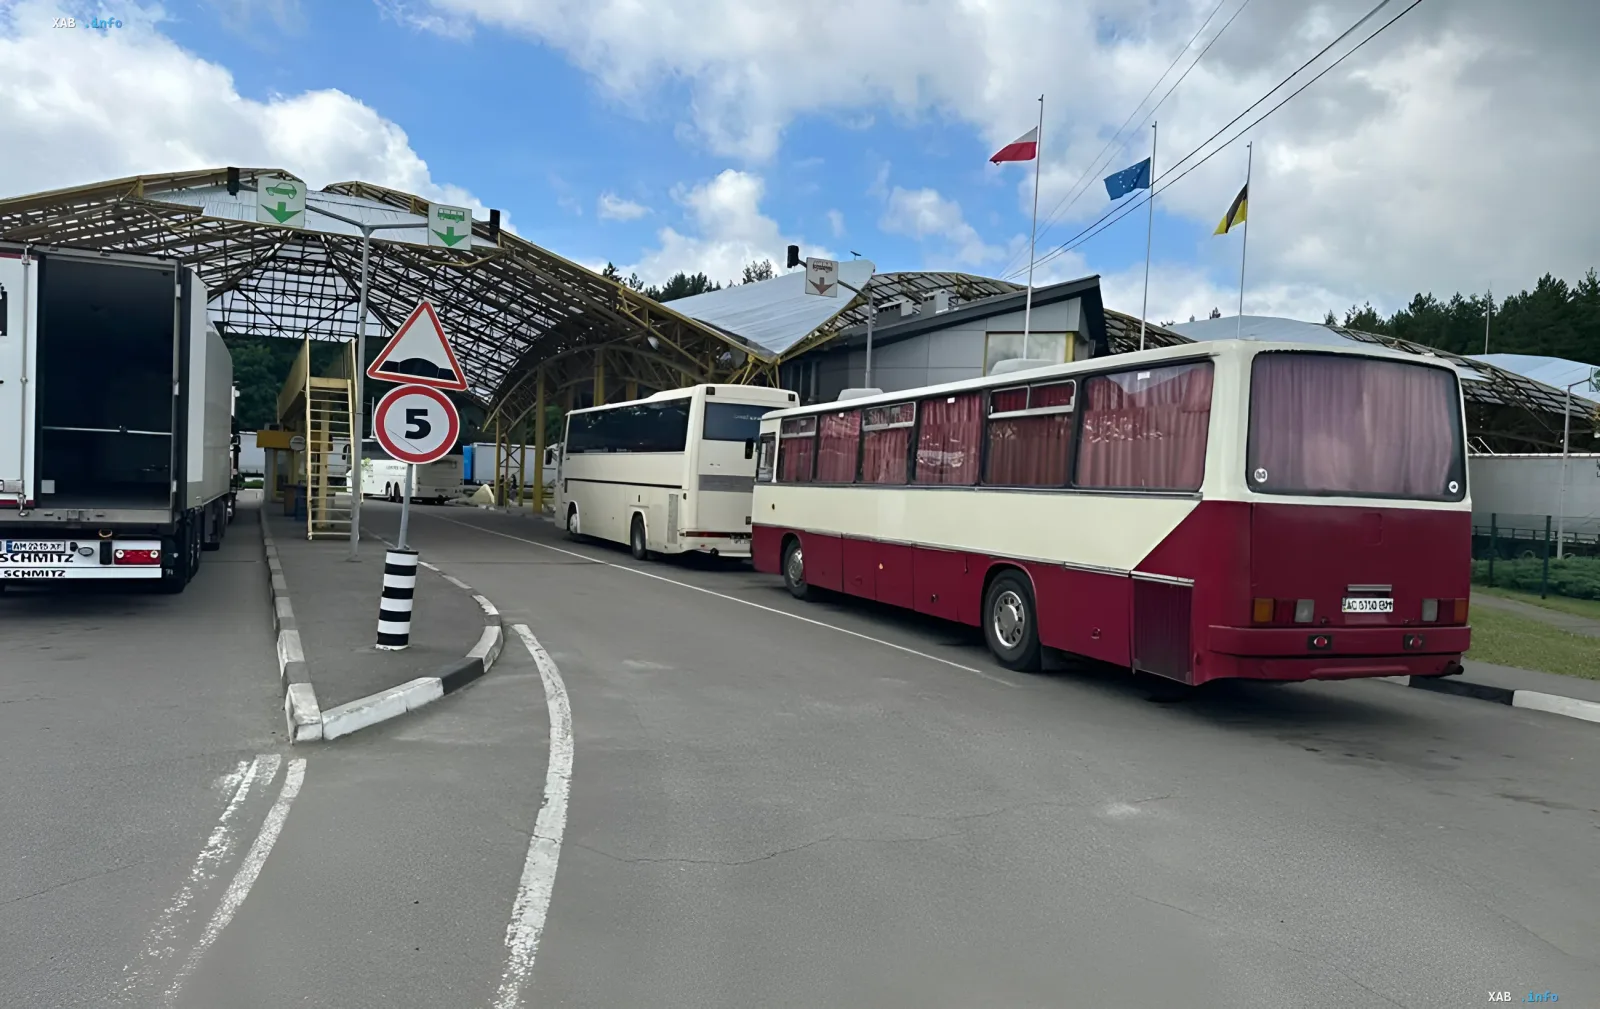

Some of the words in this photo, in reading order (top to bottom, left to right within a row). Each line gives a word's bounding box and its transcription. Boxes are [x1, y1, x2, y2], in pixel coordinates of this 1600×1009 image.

[405, 408, 431, 440] 5
[0, 553, 74, 563] SCHMITZ
[4, 569, 66, 578] SCHMITZ
